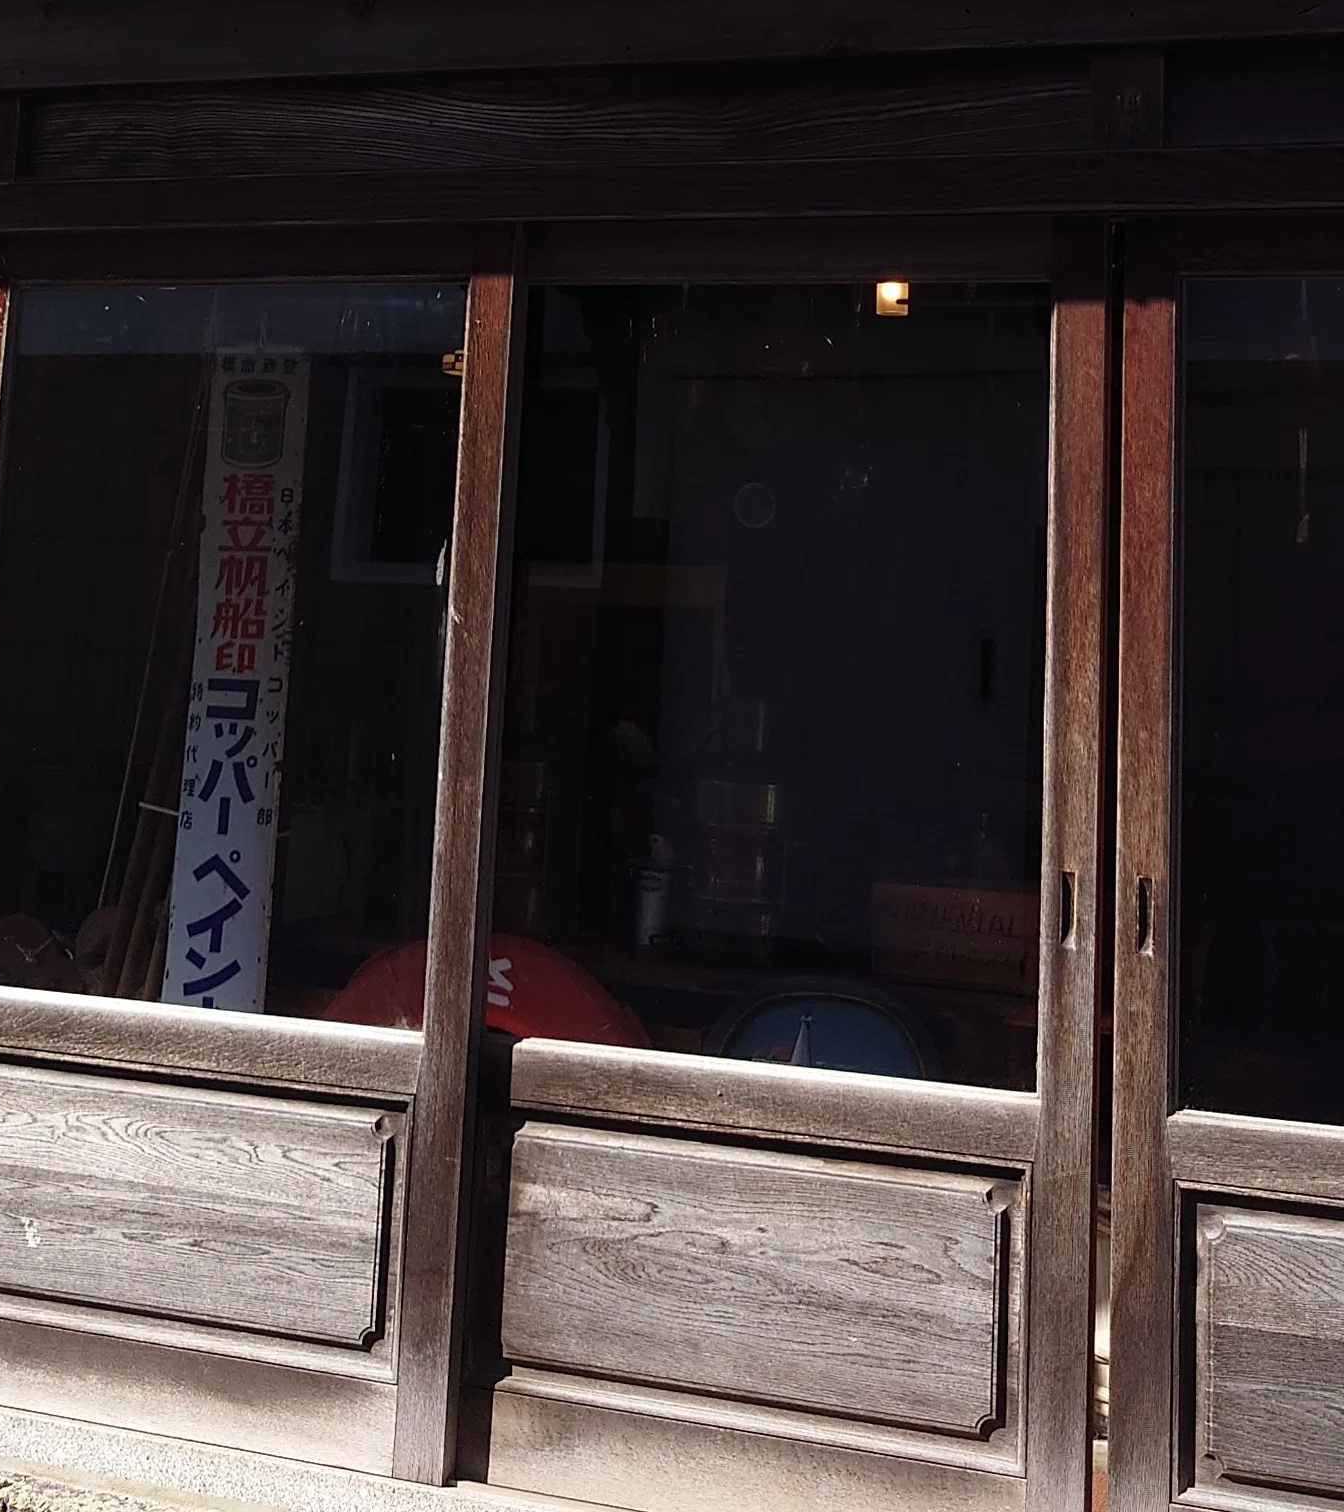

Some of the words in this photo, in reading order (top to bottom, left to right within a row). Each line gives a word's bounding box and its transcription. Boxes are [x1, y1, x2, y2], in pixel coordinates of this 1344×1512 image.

[210, 473, 276, 674] 橋立帆船印
